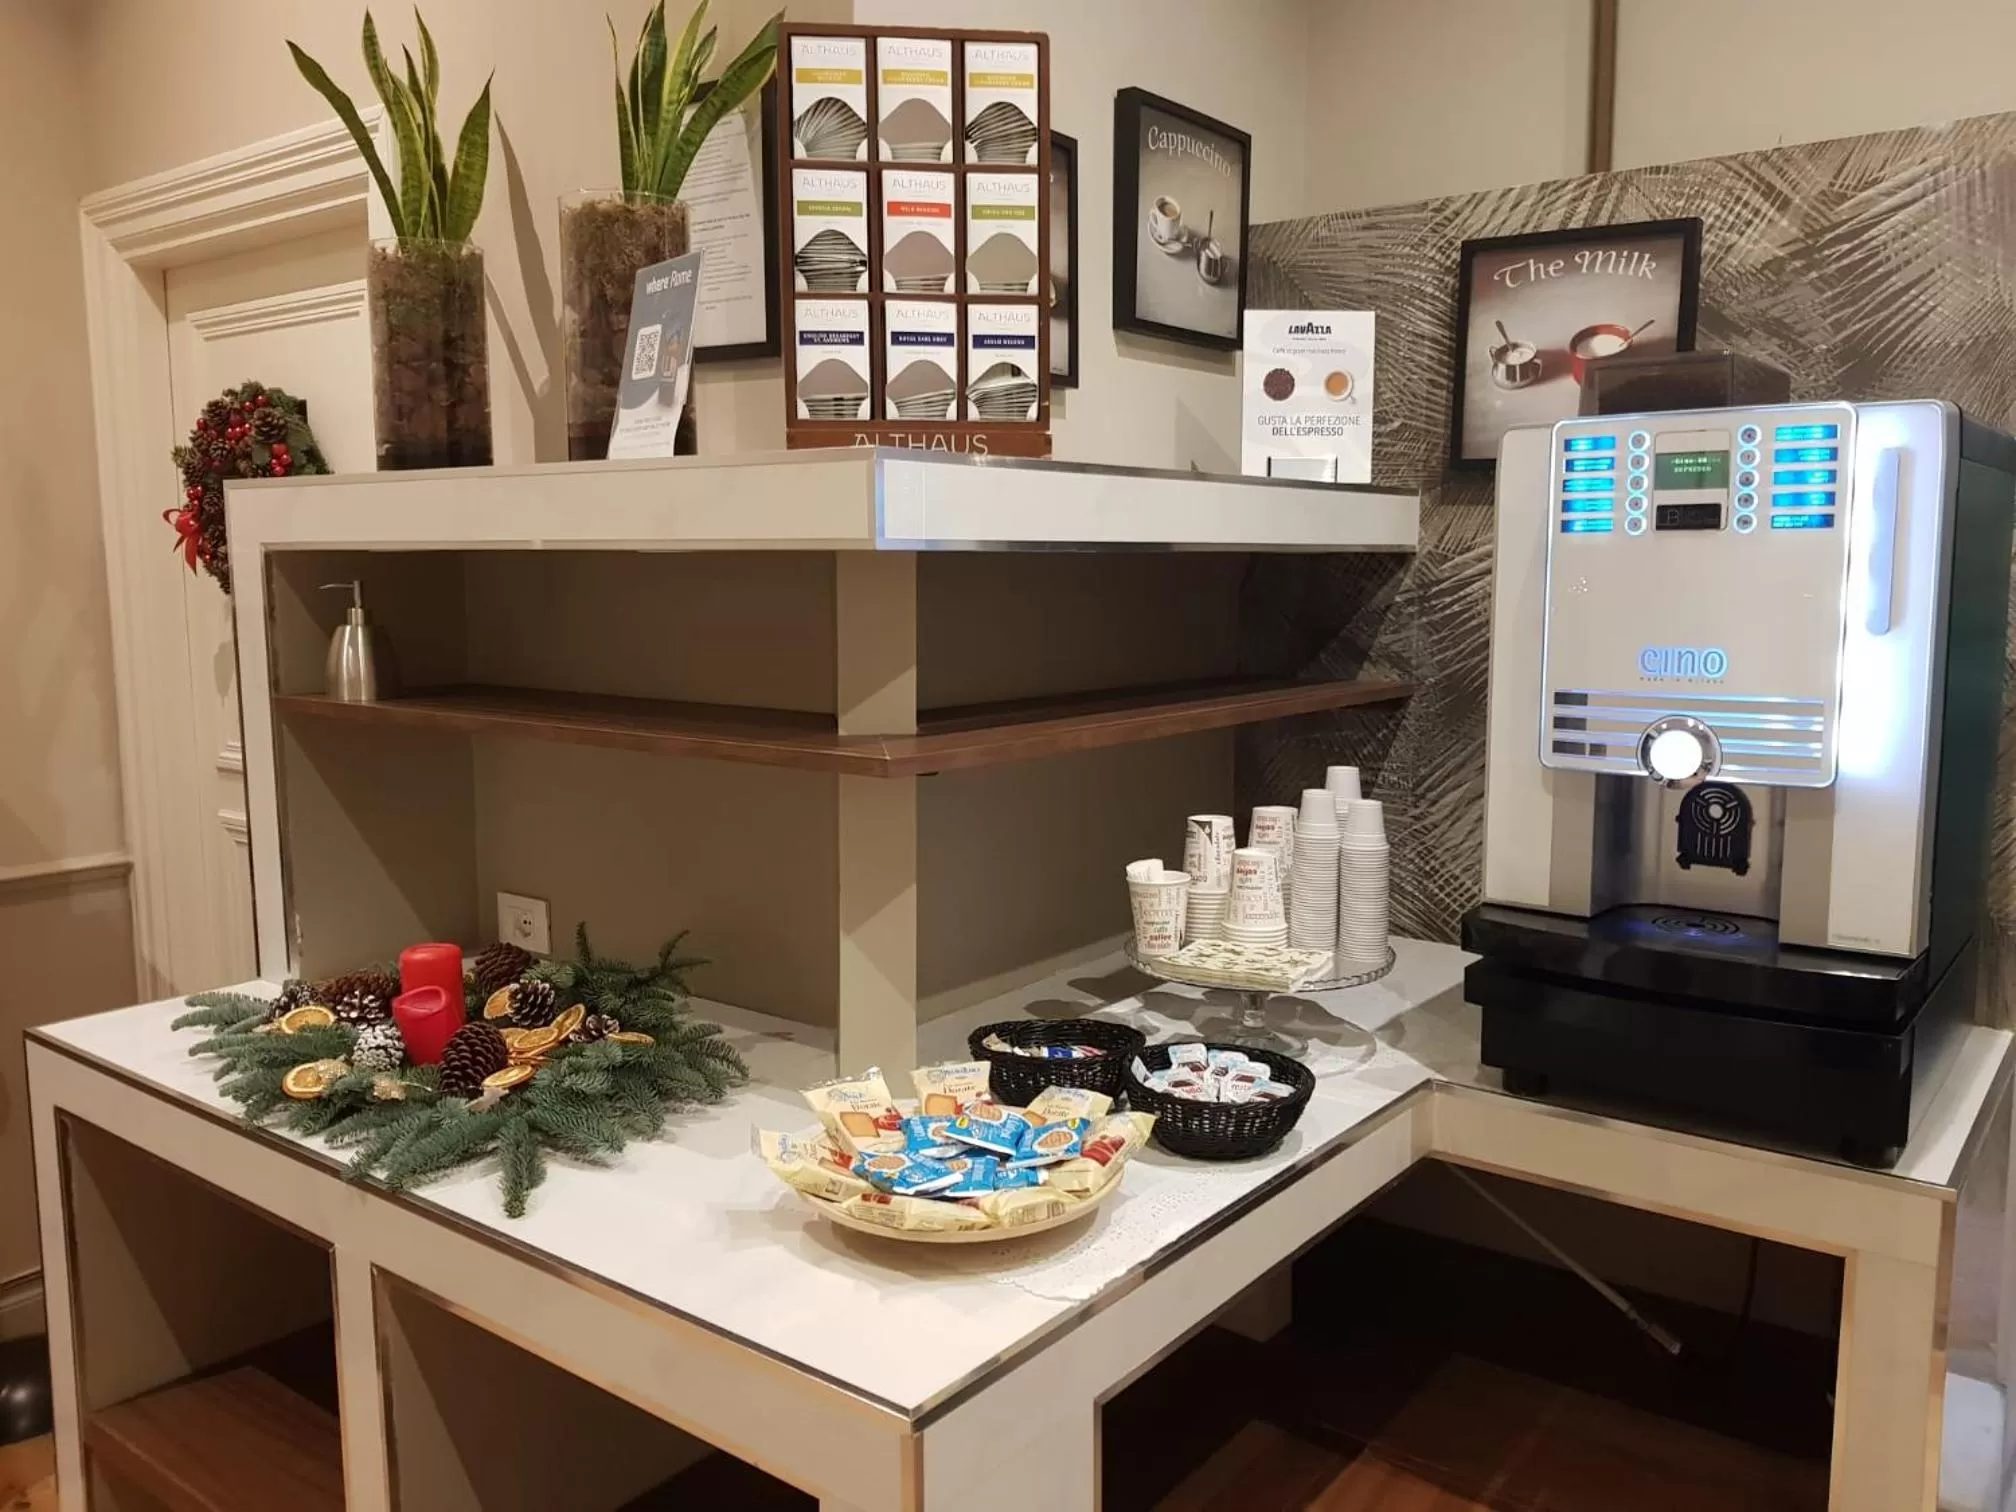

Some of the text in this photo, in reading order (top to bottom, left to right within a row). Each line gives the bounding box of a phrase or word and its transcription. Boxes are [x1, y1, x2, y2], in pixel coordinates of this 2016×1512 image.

[801, 43, 857, 57] ALTHAUS
[888, 44, 943, 58] ALTHAUS
[974, 48, 1029, 61] ALTHAUS
[1148, 125, 1232, 178] Cappuccino
[802, 176, 857, 190] ALTHAUS
[892, 177, 946, 191] ALTHAUS
[977, 180, 1030, 194] ALTHAUS
[1493, 250, 1657, 289] The Milk
[804, 306, 858, 321] ALTHAUS
[895, 307, 950, 321] ALTHAUS
[977, 311, 1030, 324] ALTHAUS
[1288, 322, 1332, 335] LAVAZZA
[1258, 416, 1361, 426] GUSTA LA PERFEZIONE
[1272, 427, 1344, 437] DELL'ESPRESSO
[855, 433, 988, 456] ALTHAUS
[1640, 648, 1725, 675] cino
